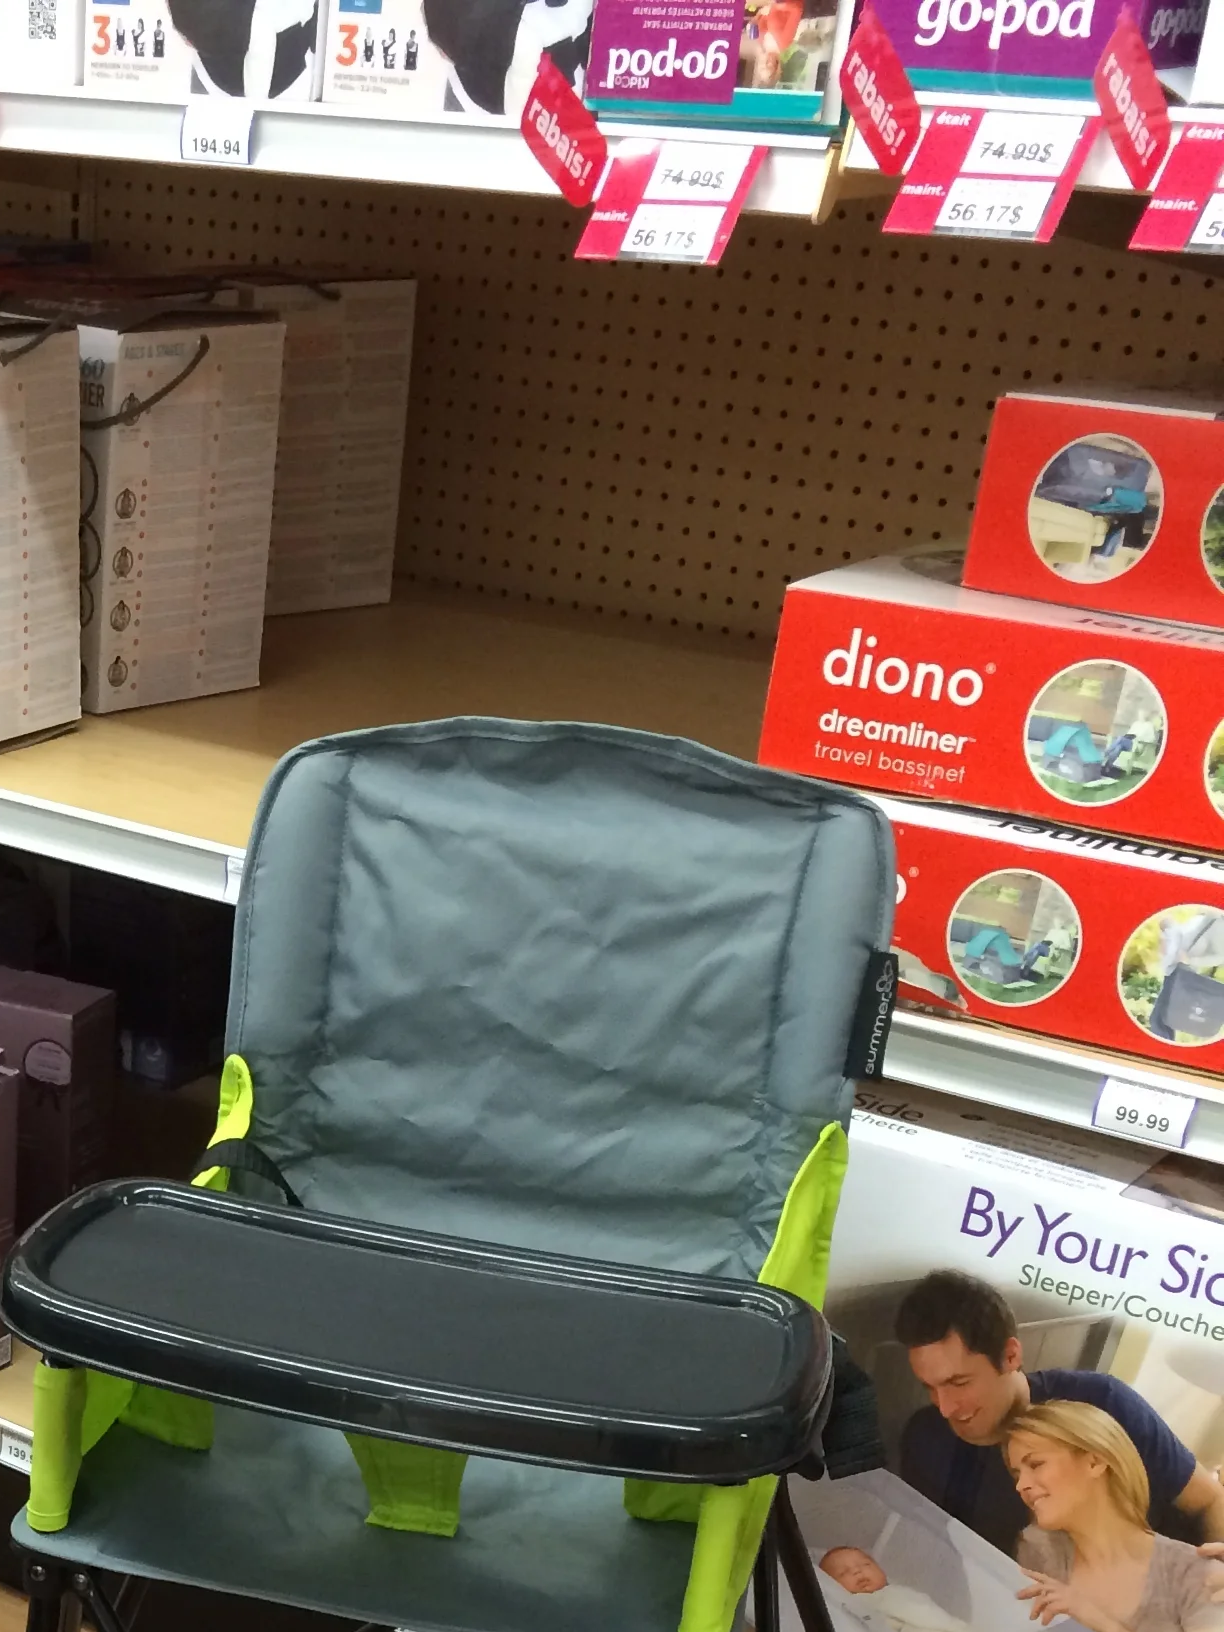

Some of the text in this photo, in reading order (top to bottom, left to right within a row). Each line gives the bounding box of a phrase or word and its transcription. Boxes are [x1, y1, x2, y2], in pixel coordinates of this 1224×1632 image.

[91, 15, 111, 56] 3
[335, 24, 359, 67] 3
[846, 50, 907, 156] rabais!
[1102, 53, 1158, 167] rabais!
[191, 137, 241, 157] 194.94
[527, 98, 593, 188] rabais!
[901, 183, 946, 197] maint.
[1148, 199, 1199, 212] maint.
[80, 356, 106, 380] 60
[822, 627, 985, 707] diono
[818, 708, 970, 756] dreamliner
[813, 741, 966, 785] travel bassinet
[864, 991, 893, 1076] summer
[853, 1092, 925, 1123] Side
[1114, 1105, 1171, 1134] 99.99
[959, 1186, 1025, 1259] By
[1033, 1203, 1149, 1280] Your
